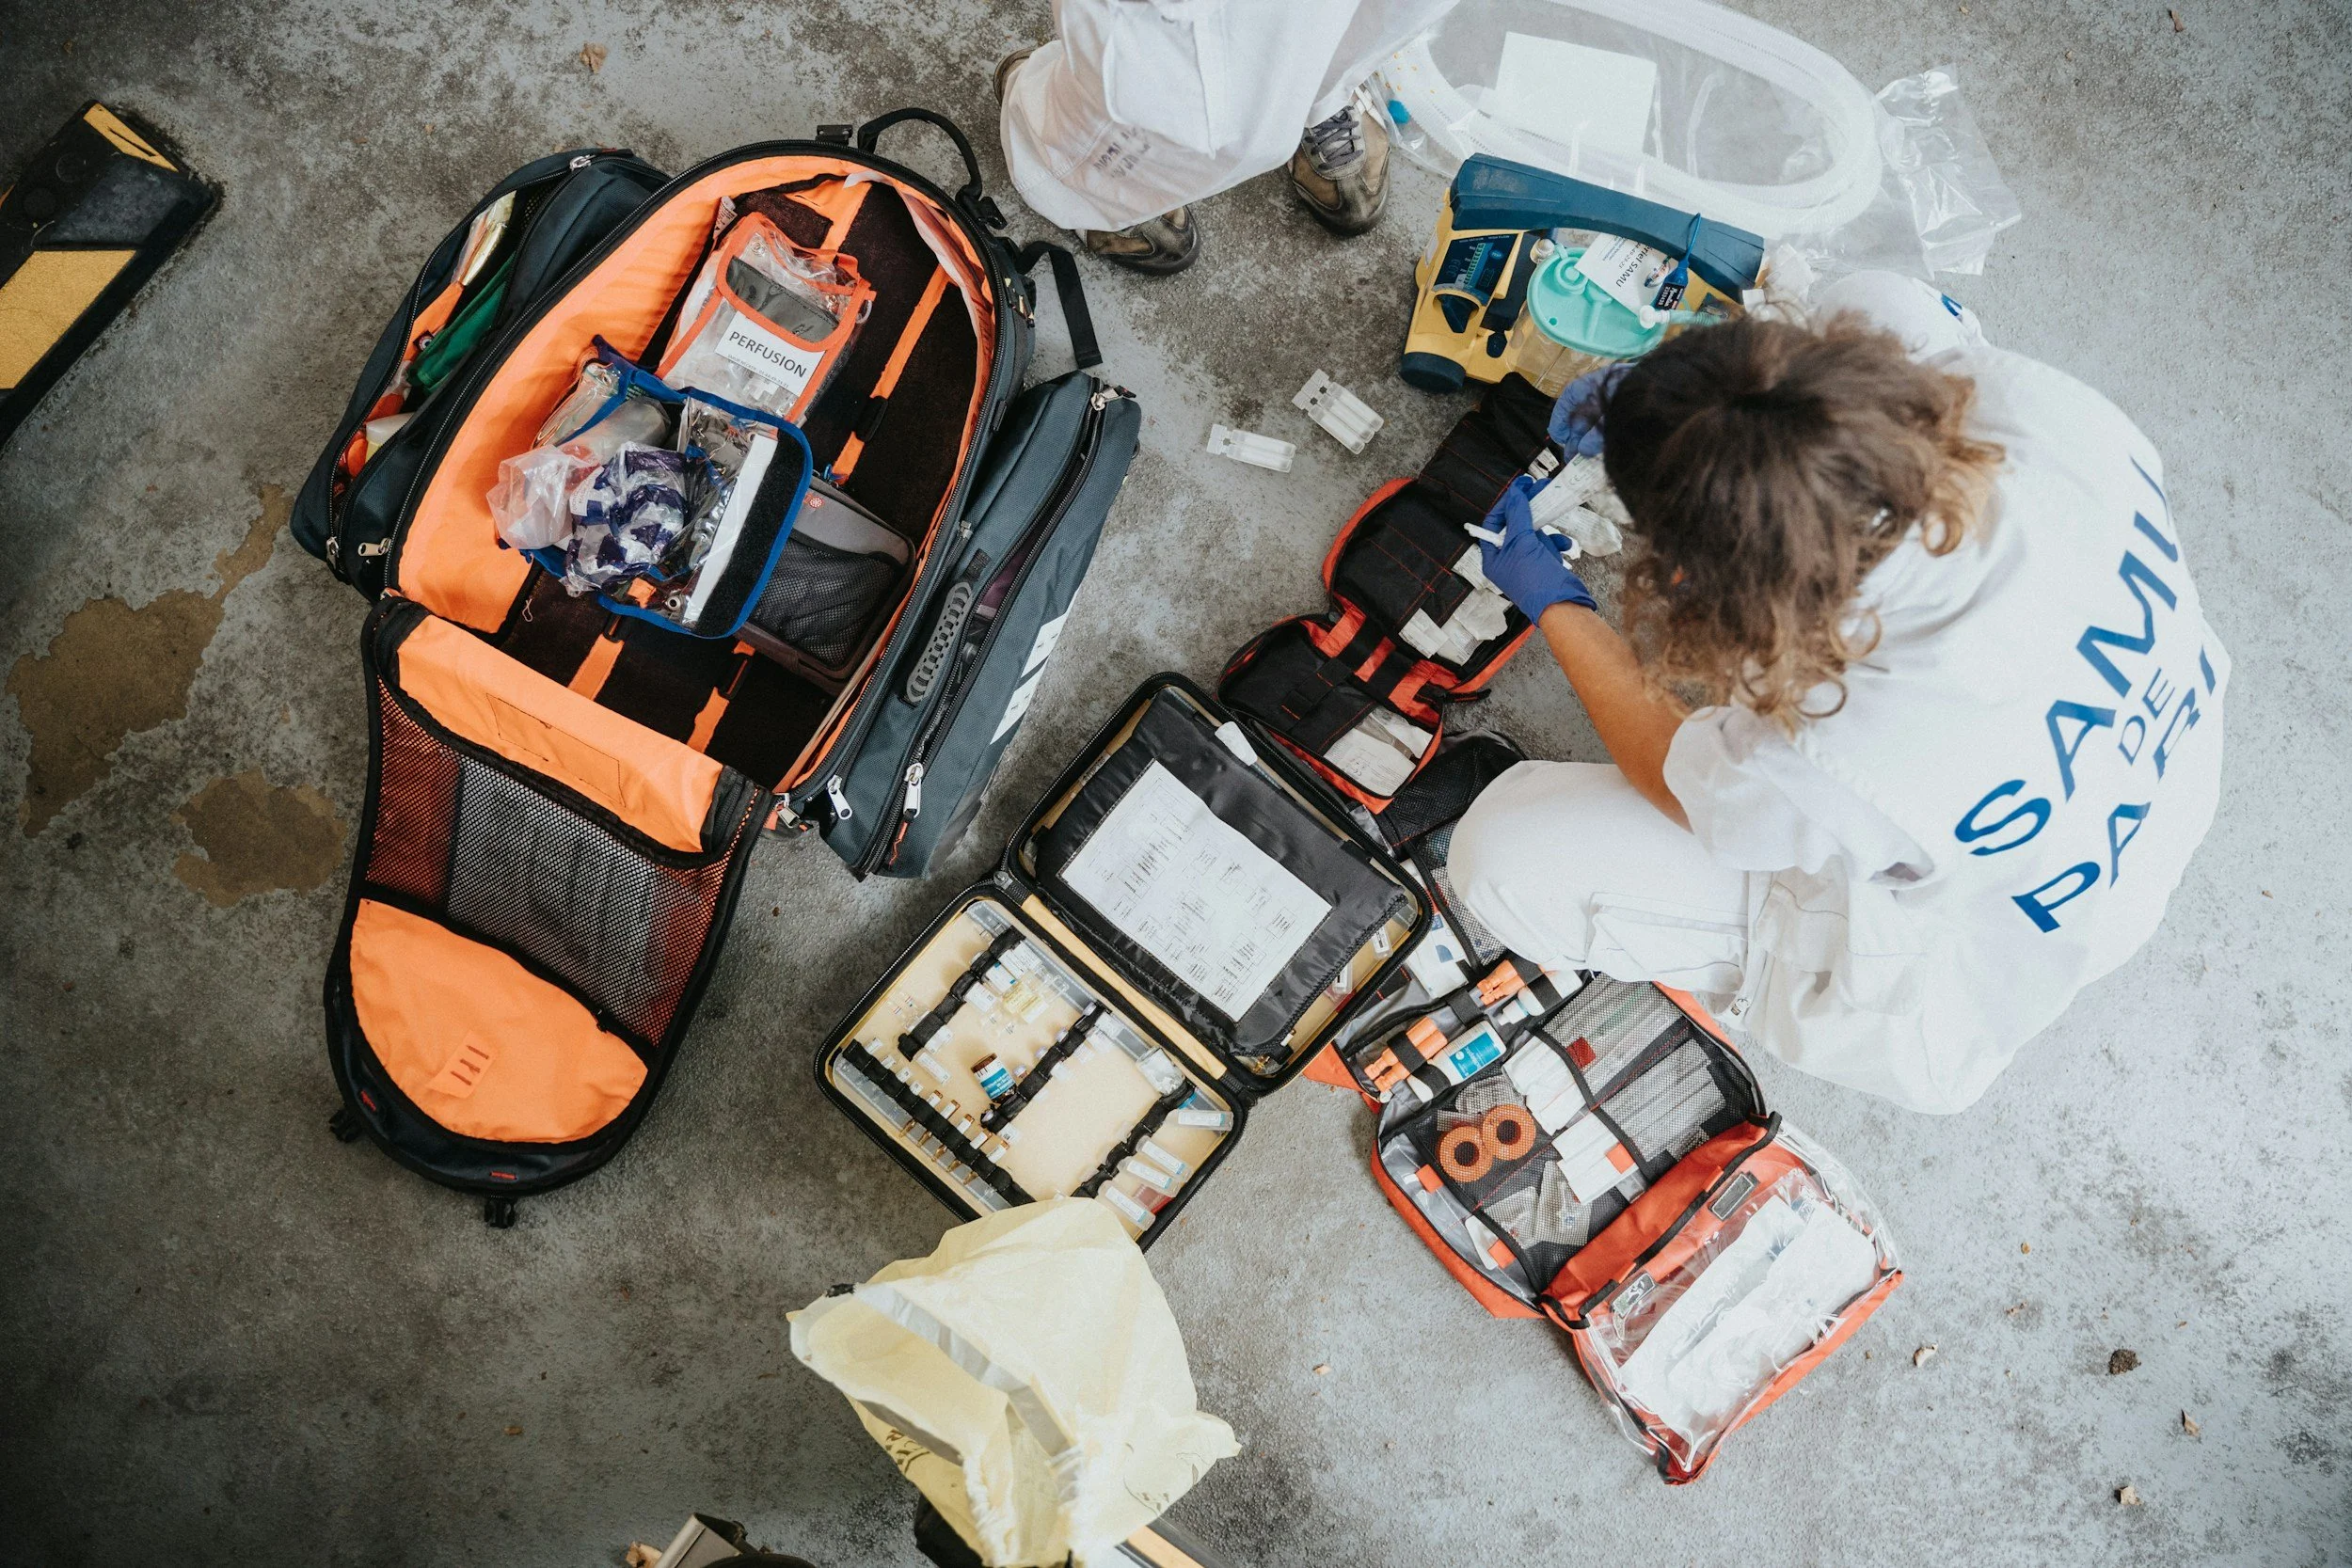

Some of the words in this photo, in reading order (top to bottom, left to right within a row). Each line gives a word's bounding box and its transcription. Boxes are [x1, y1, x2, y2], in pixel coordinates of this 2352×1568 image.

[1615, 261, 1638, 288] SAMU
[729, 332, 806, 377] PERFUSION
[2119, 667, 2175, 766] DE
